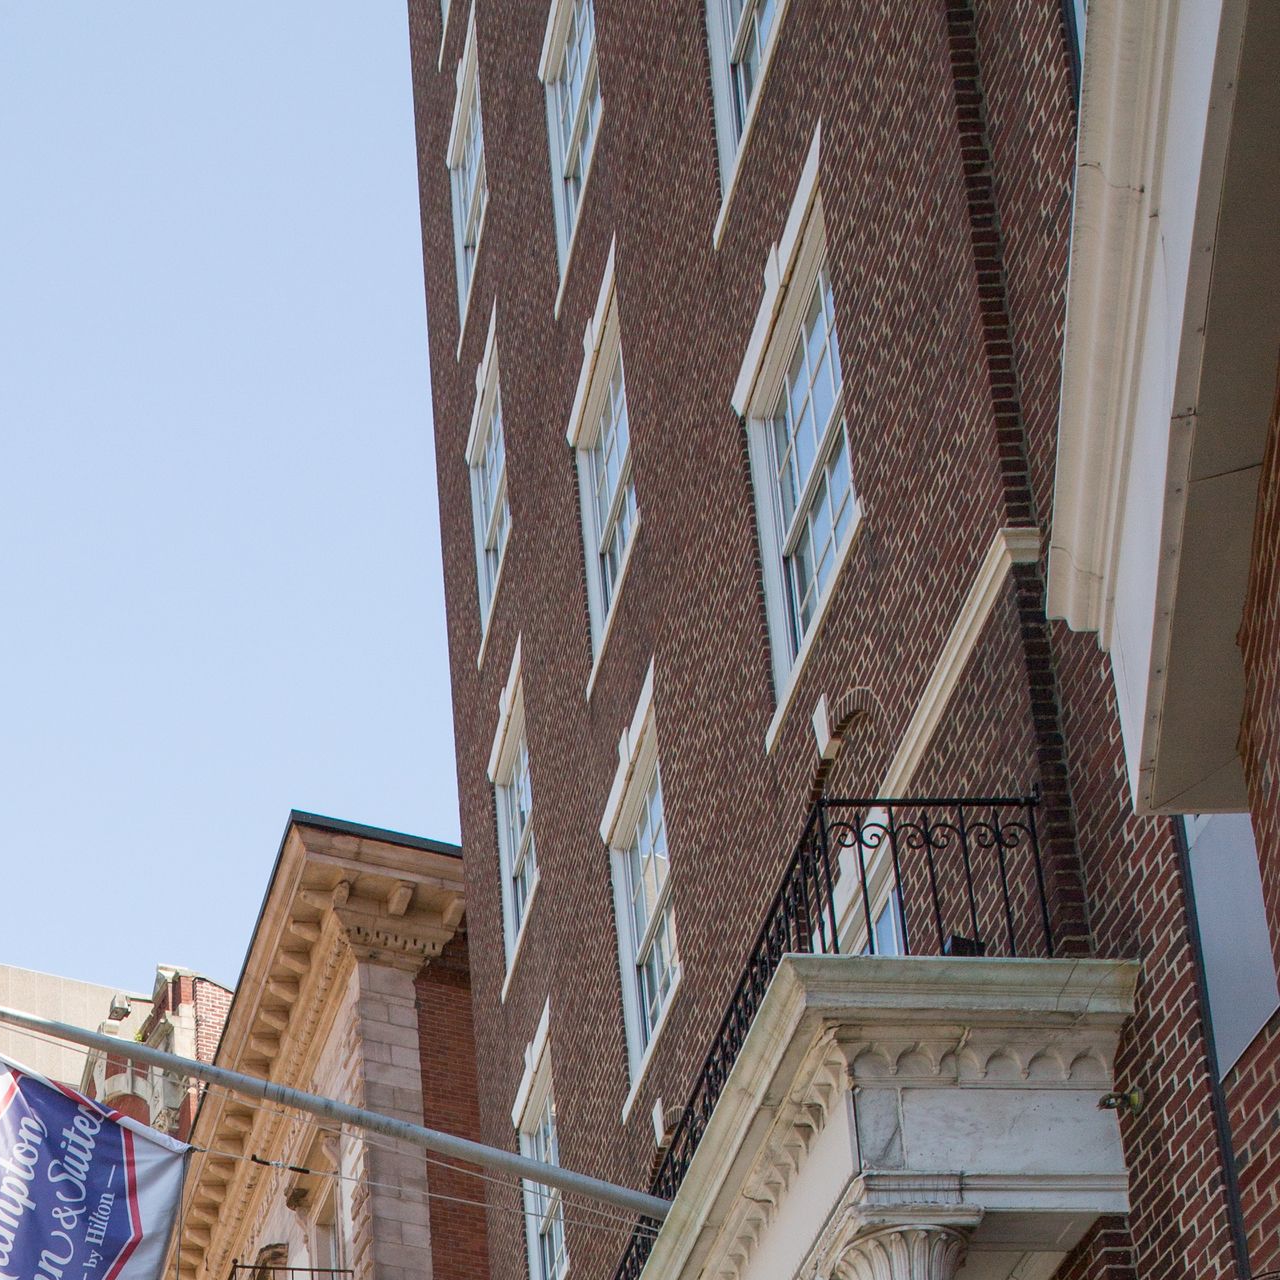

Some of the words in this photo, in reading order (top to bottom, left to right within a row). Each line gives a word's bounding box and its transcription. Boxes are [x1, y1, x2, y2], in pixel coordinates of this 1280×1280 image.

[47, 1104, 105, 1204] Suites
[52, 1197, 87, 1231] &
[84, 1190, 116, 1248] Hilton
[83, 1249, 105, 1270] by
